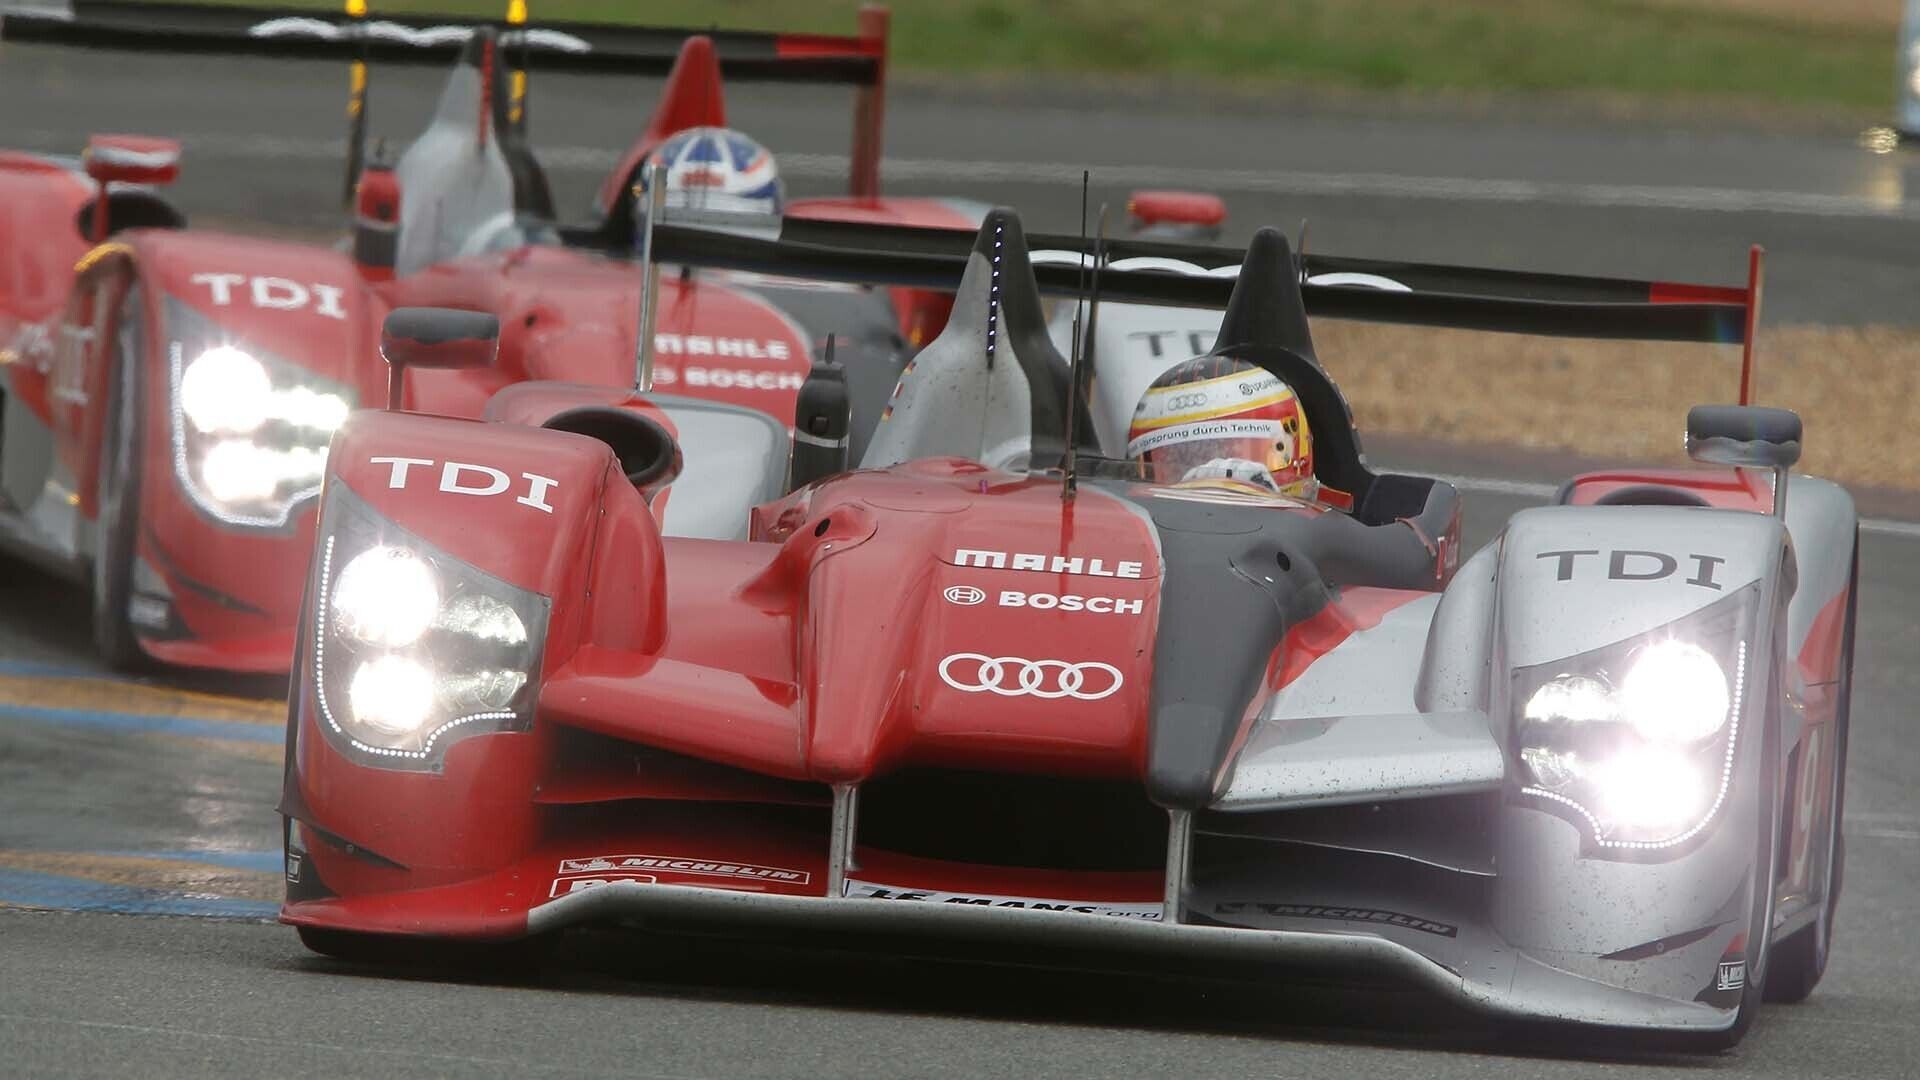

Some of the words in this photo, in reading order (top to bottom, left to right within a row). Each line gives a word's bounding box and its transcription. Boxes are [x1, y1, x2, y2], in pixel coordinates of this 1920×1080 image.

[192, 272, 346, 319] TDI
[685, 367, 804, 390] BOSCH
[1192, 425, 1228, 435] durch
[1231, 424, 1272, 433] Technik
[370, 456, 559, 514] TDI
[954, 548, 1143, 579] MAHLE
[1536, 549, 1726, 591] TDI
[999, 590, 1143, 615] BOSCH
[622, 858, 800, 880] MICHELIN
[1275, 906, 1449, 933] MICHELIN
